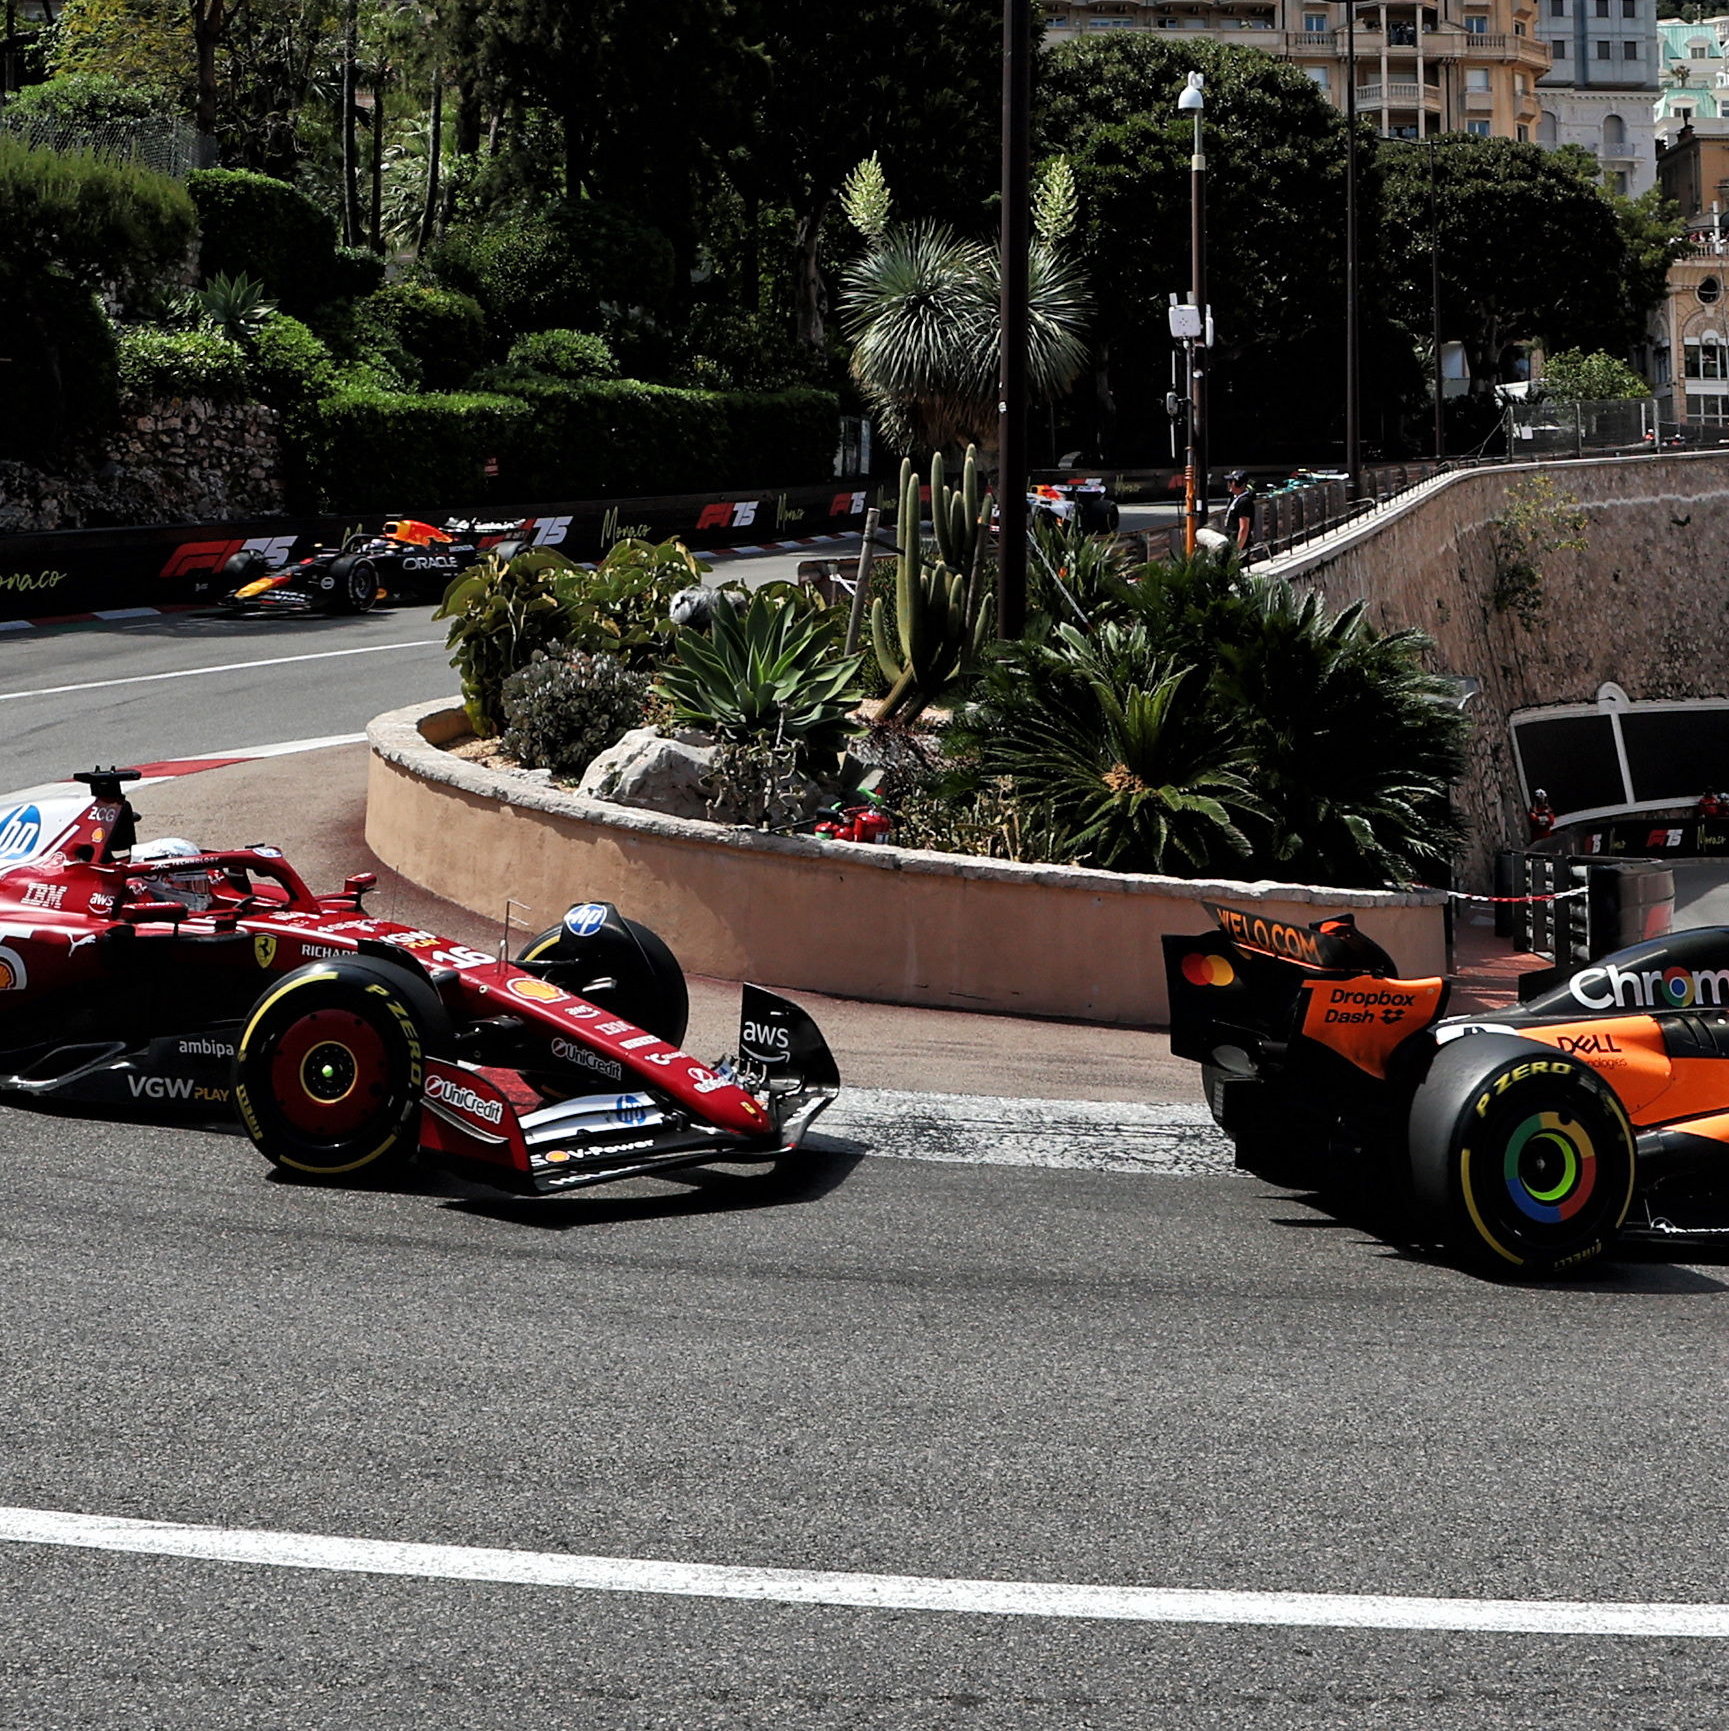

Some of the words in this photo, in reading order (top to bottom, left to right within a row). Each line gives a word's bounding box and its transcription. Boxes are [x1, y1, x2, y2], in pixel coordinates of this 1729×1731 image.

[696, 502, 735, 529] F1
[732, 501, 759, 527] 75
[531, 516, 573, 546] 75
[403, 556, 458, 570] ORACLE
[21, 882, 68, 908] IBM
[89, 892, 115, 908] aws
[570, 905, 605, 936] hp
[1216, 907, 1322, 965] VELO.COM
[430, 946, 498, 970] 16
[1330, 988, 1417, 1008] Dropbox
[1325, 1009, 1375, 1024] Dash
[179, 1038, 235, 1058] ambipa
[365, 984, 391, 997] P
[386, 1001, 423, 1086] ZERO
[744, 1020, 790, 1049] aws
[1557, 1033, 1622, 1055] DELL
[567, 1044, 622, 1081] UniCredit
[127, 1074, 194, 1099] VGW
[194, 1087, 230, 1102] PLAY
[1476, 1092, 1490, 1118] P
[1494, 1061, 1573, 1097] ZERO
[442, 1081, 503, 1124] UniCredit
[567, 1139, 655, 1159] V-Power
